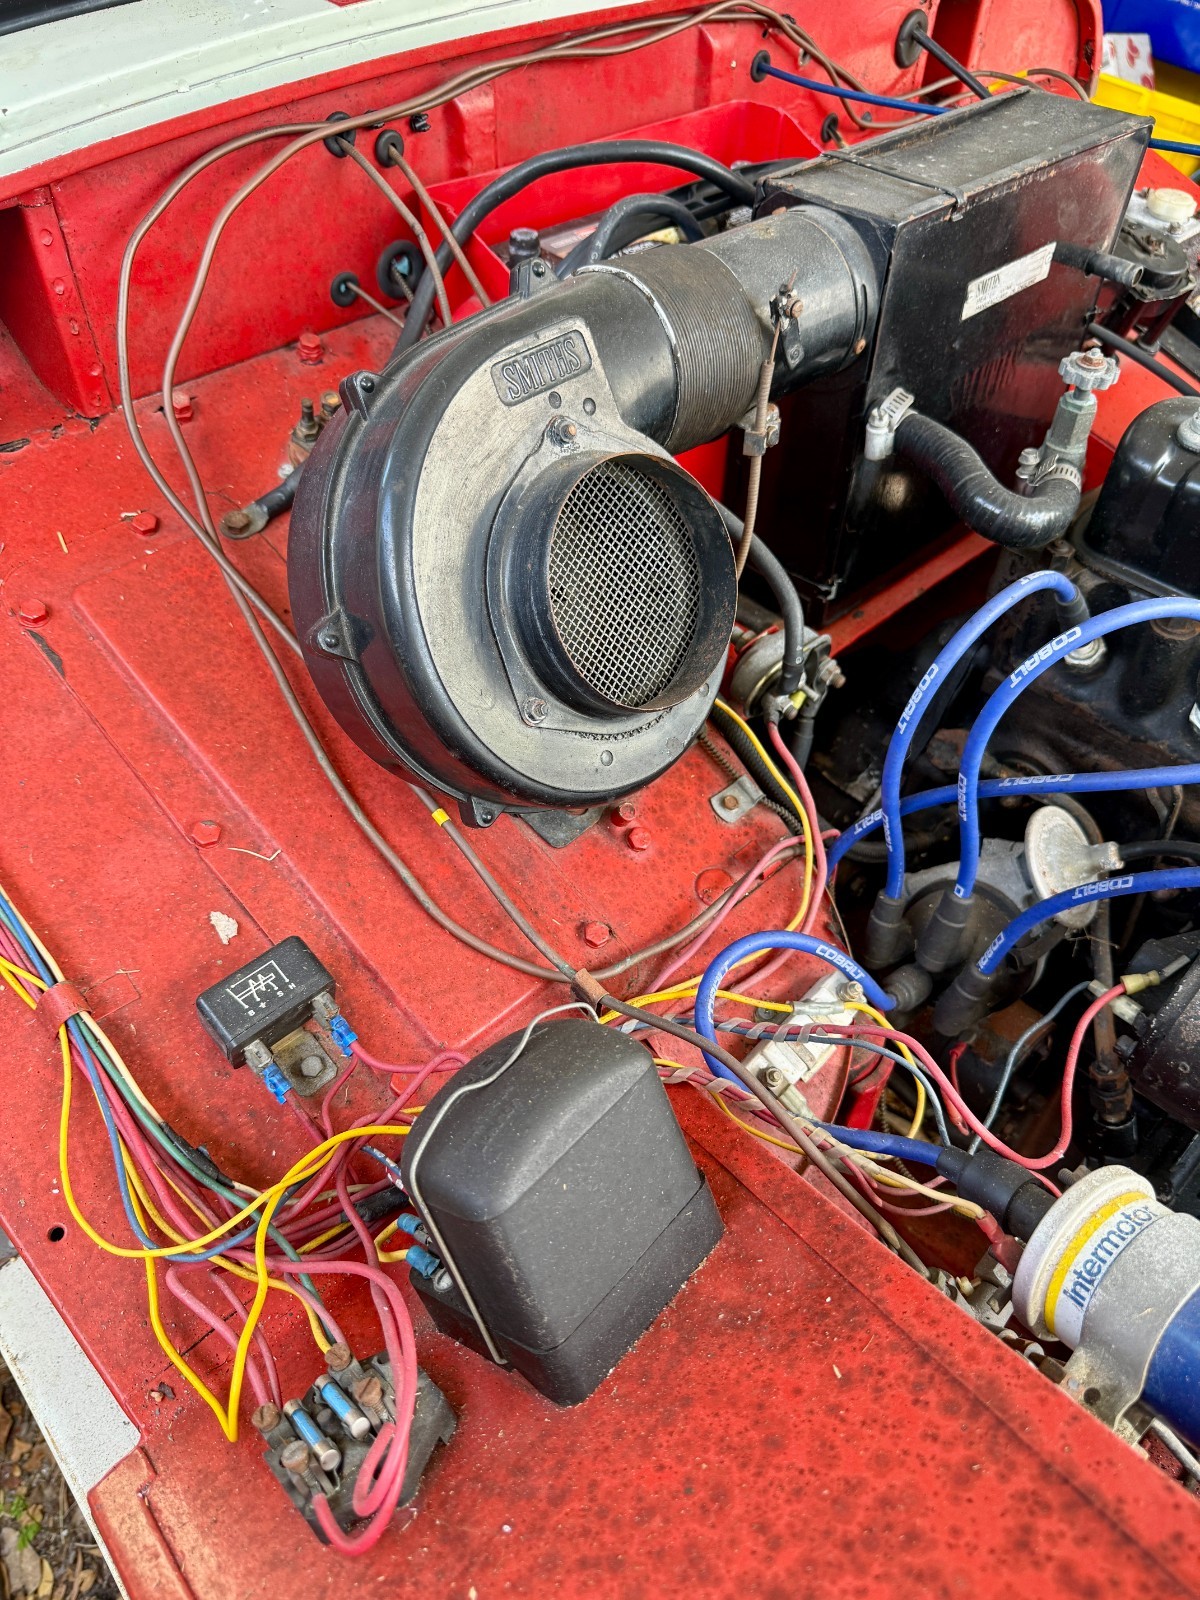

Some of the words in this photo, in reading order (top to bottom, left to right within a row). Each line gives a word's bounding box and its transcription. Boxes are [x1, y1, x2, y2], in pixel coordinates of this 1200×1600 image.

[502, 339, 581, 399] SMITHS
[1010, 626, 1083, 688] COBALT
[898, 663, 939, 734] COBALT
[999, 773, 1074, 787] COBALT
[854, 808, 883, 835] BALT
[1072, 875, 1134, 900] COBALT
[815, 944, 865, 980] COBALT
[976, 931, 1005, 972] COBAL
[1062, 1205, 1159, 1309] Intermotor
